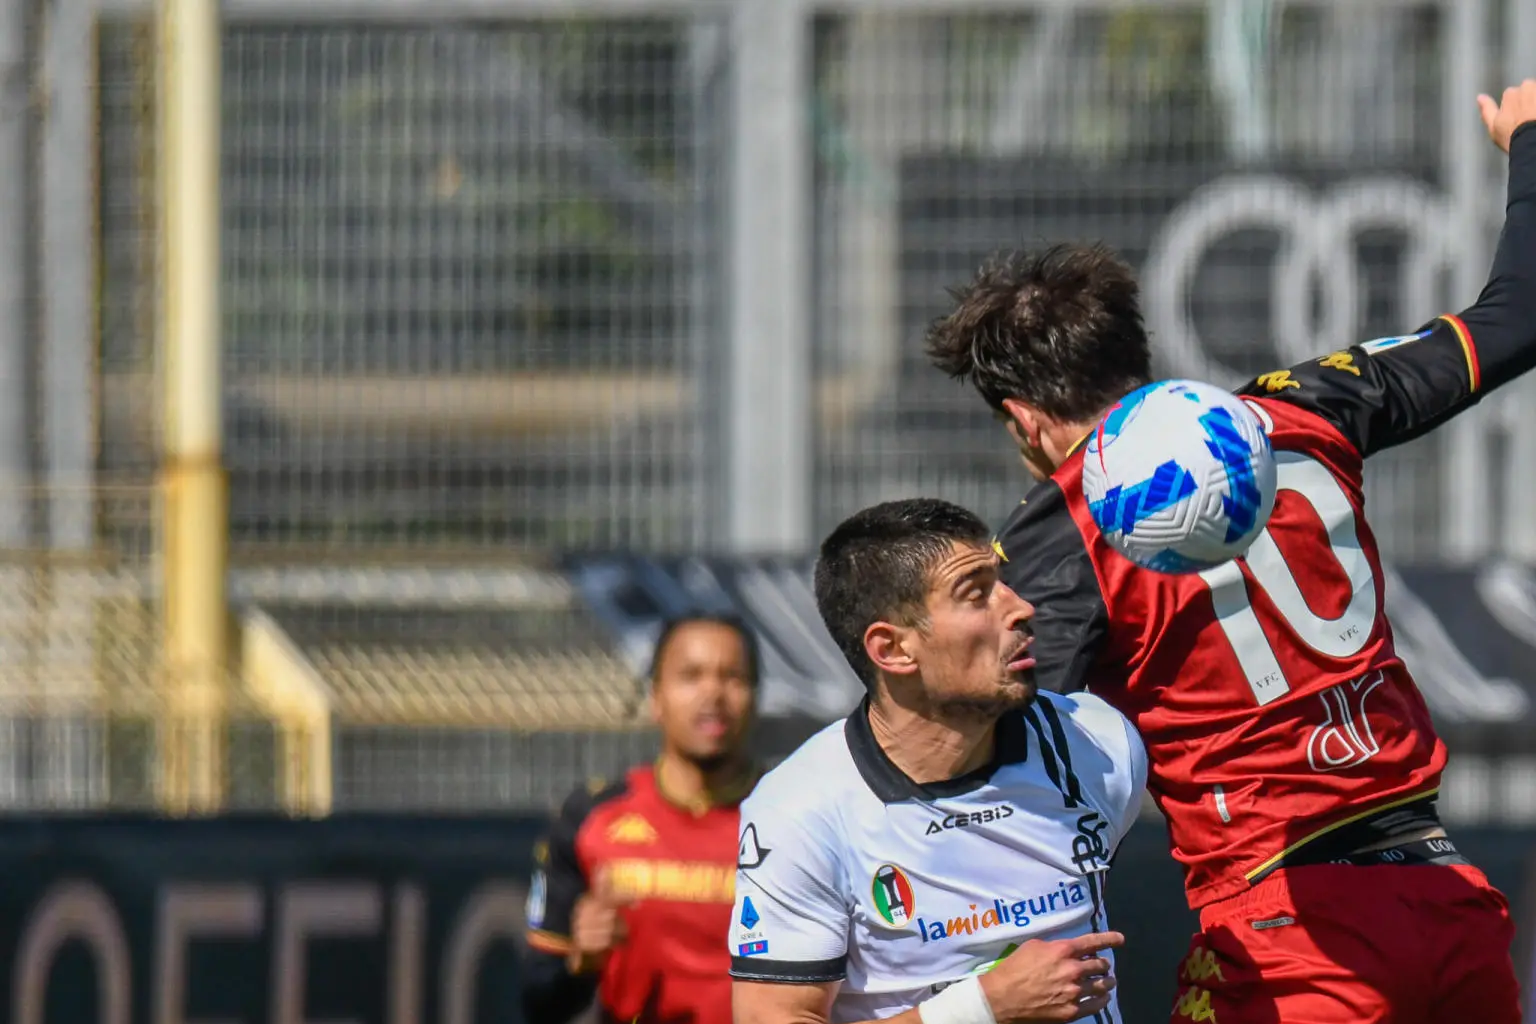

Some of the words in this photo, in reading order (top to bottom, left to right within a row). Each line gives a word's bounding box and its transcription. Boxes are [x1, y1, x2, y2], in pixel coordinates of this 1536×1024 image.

[1198, 450, 1376, 706] 10
[1338, 624, 1359, 642] VFC
[1255, 672, 1279, 689] VFC
[925, 805, 1014, 836] ACERBIS
[917, 881, 1085, 943] lamialiguria
